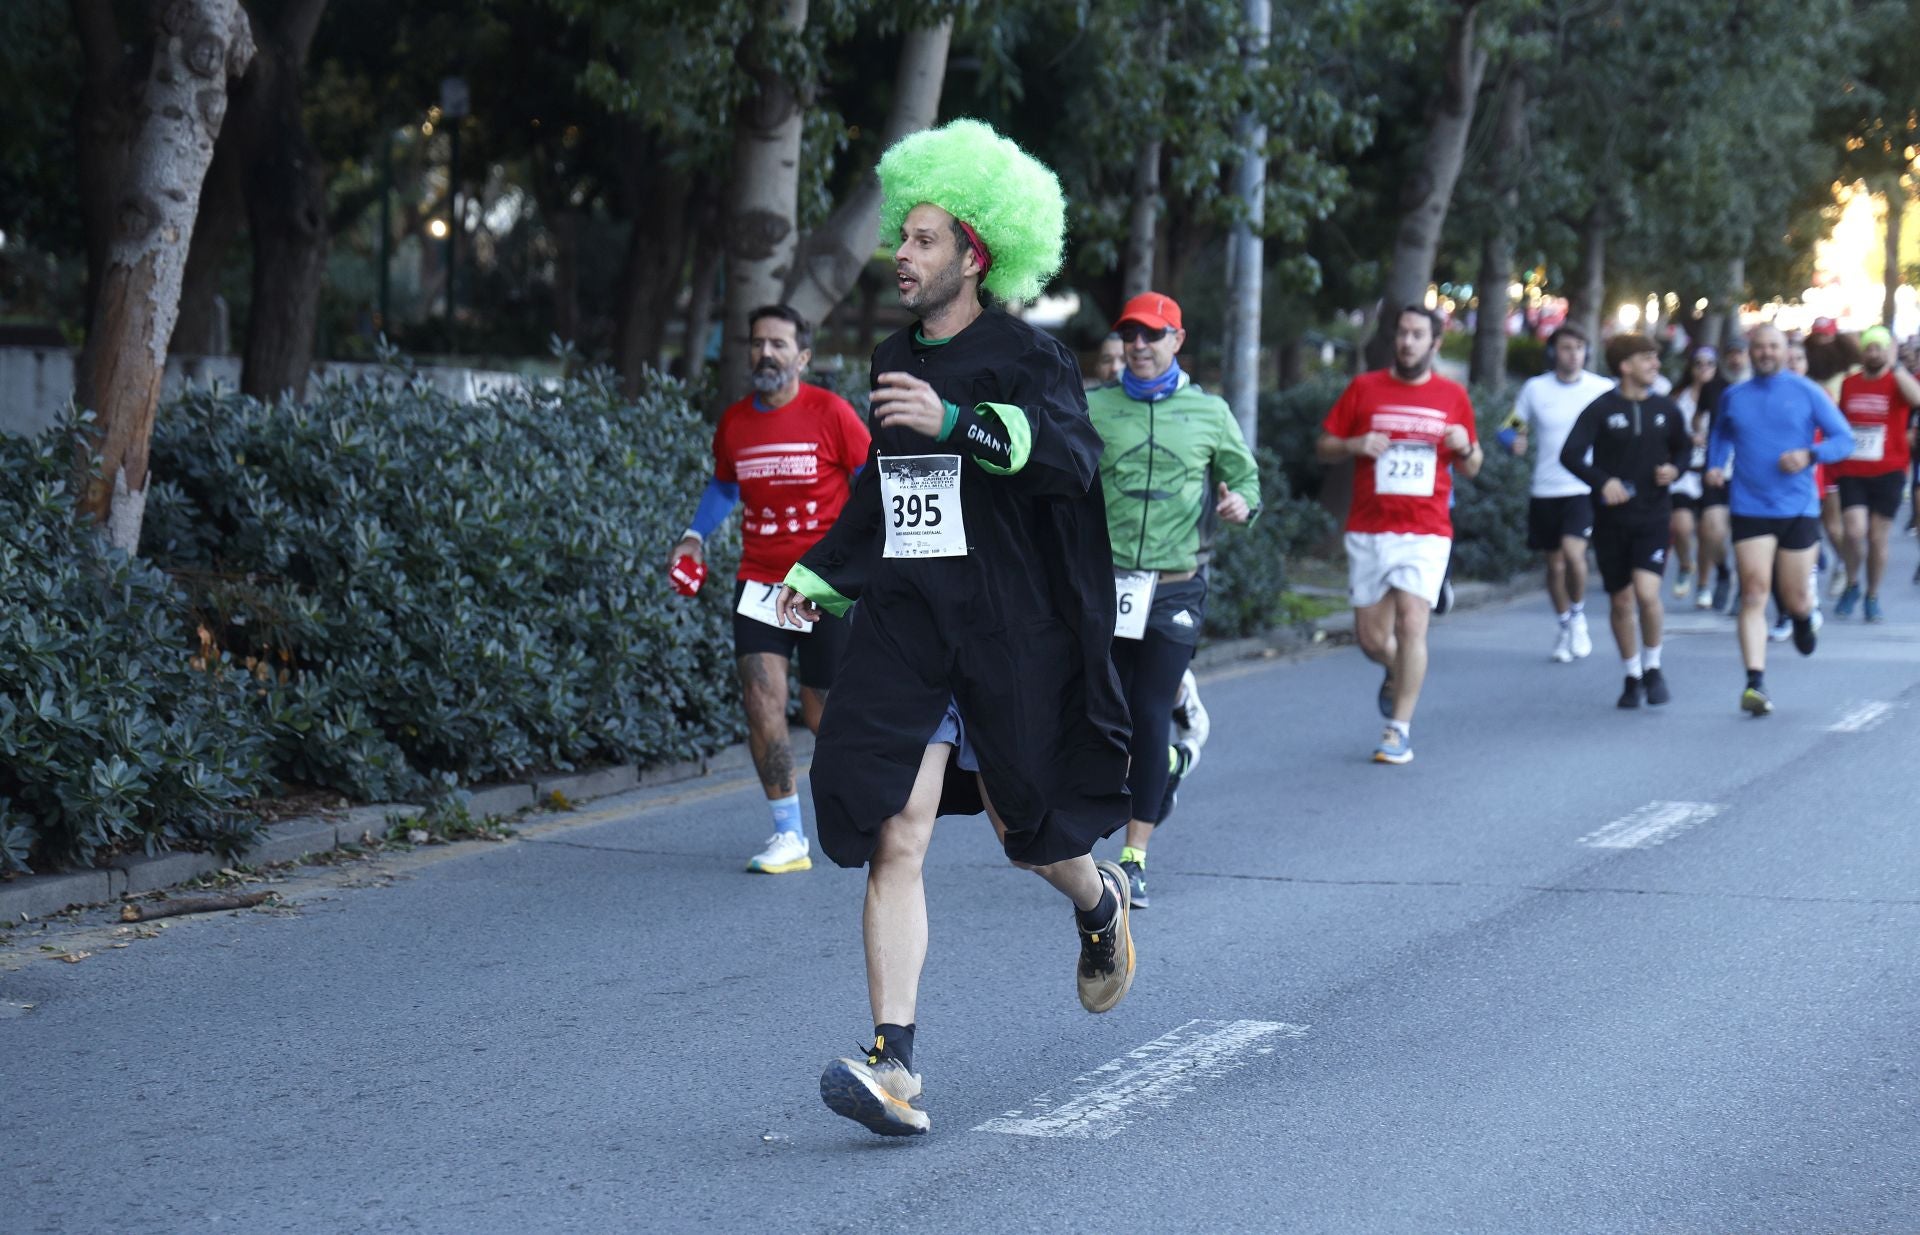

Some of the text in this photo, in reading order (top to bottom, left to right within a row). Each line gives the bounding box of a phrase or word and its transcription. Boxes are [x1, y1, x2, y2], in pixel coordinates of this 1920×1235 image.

[968, 424, 1001, 452] GRAN
[1388, 461, 1424, 478] 228
[892, 494, 942, 528] 395
